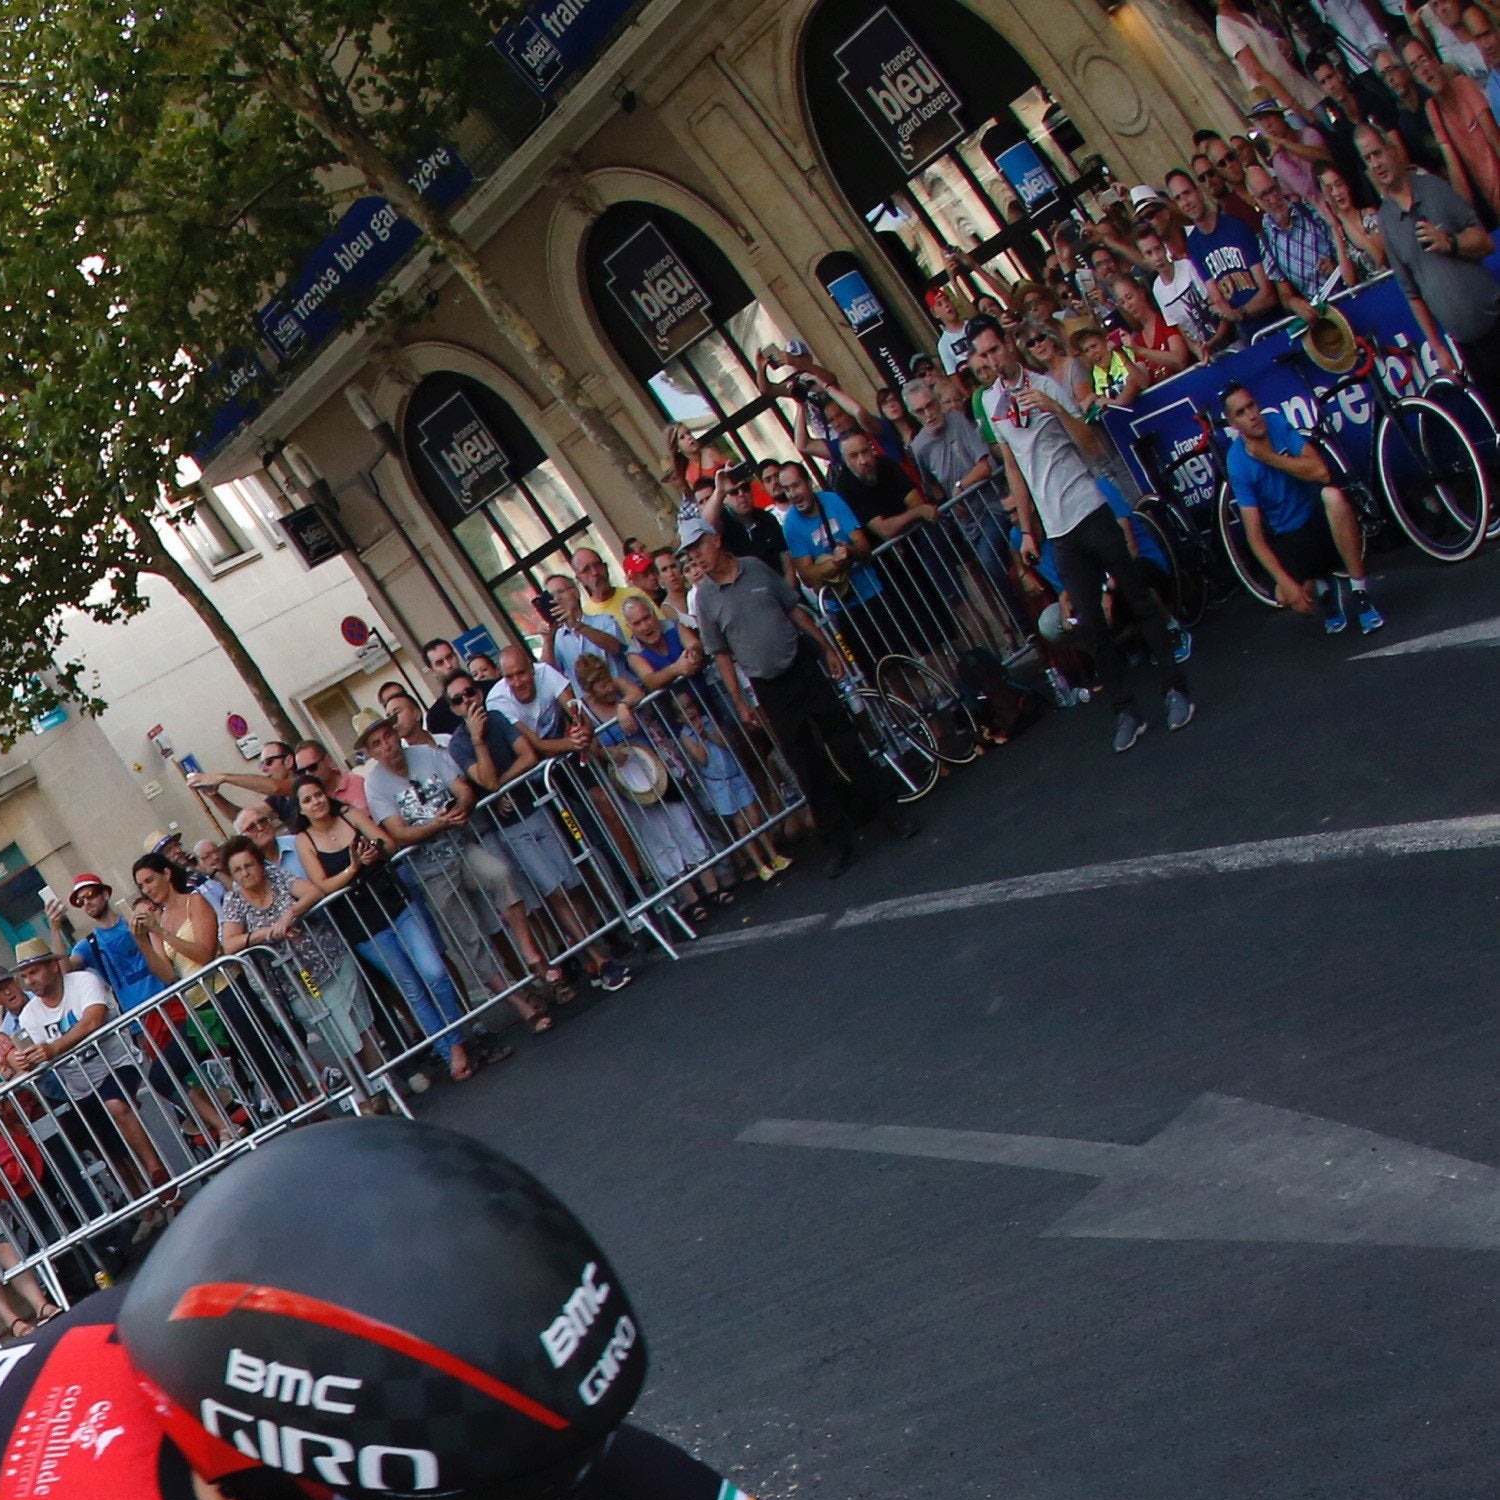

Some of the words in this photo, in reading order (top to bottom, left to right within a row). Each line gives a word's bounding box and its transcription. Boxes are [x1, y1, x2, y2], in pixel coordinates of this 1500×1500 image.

[866, 58, 940, 124] bleu
[881, 45, 917, 77] france
[897, 113, 922, 141] gard
[334, 230, 374, 273] bleu
[370, 204, 399, 242] gar
[631, 265, 693, 321] bleu
[441, 430, 495, 477] bleu
[1174, 432, 1205, 457] franc
[539, 1261, 610, 1369] BMC
[225, 1348, 364, 1415] BMC
[577, 1315, 638, 1406] GIRO
[33, 1384, 82, 1497] coquillade
[200, 1397, 440, 1491] GIRO
